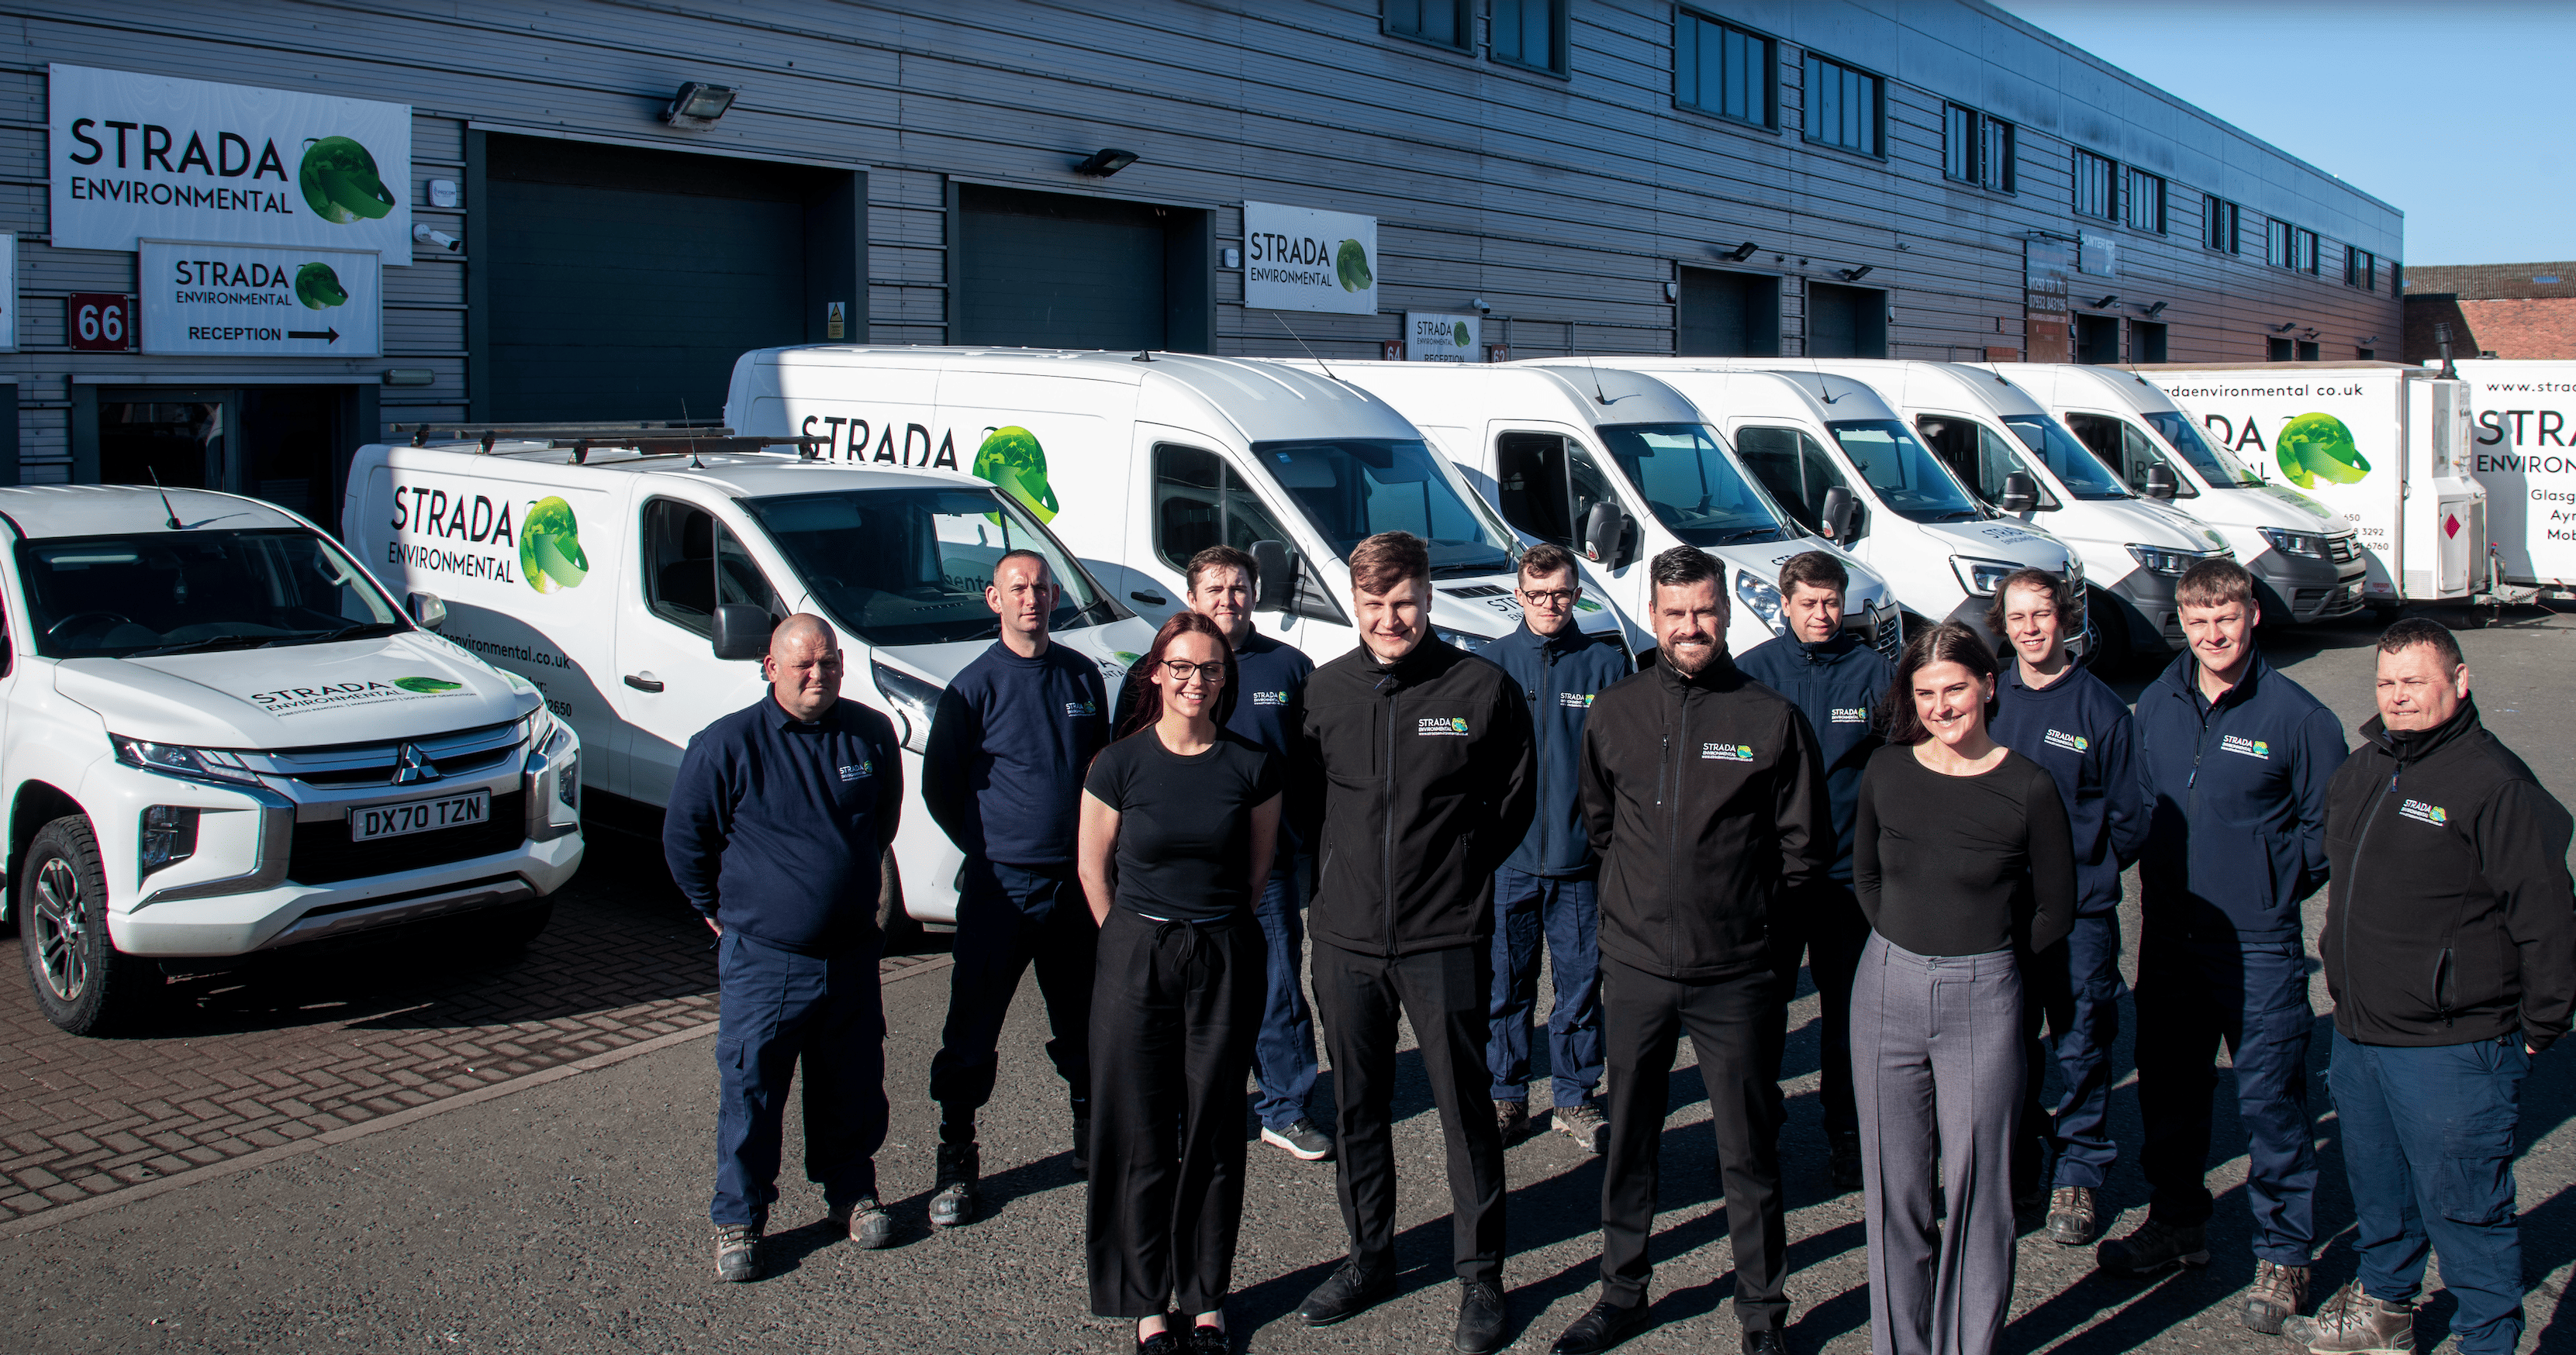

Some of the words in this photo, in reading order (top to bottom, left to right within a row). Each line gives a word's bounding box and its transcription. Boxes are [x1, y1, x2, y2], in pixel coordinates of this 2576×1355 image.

[69, 118, 288, 181] STRADA
[71, 177, 293, 214] ENVIRONMENTAL
[1250, 232, 1331, 267] STRADA
[175, 260, 289, 288] STRADA
[1251, 267, 1332, 287] ENVIRONMENTAL
[2028, 277, 2045, 291] 01292
[2046, 279, 2056, 293] 737
[2056, 281, 2066, 295] 727
[176, 291, 292, 306] ENVIRONMENTAL
[2029, 295, 2046, 309] 07932
[2047, 297, 2066, 312] 843196
[79, 304, 123, 341] 66
[1417, 321, 1452, 336] STRADA
[189, 326, 281, 341] RECEPTION
[1386, 347, 1401, 361] 64
[1424, 354, 1465, 363] RECEPTION
[1493, 350, 1505, 363] 62
[2317, 384, 2363, 396] co.uk
[799, 415, 958, 471] STRADA
[2477, 455, 2576, 473] ENVIRON
[2531, 489, 2576, 505] Glasg
[390, 485, 515, 547] STRADA
[389, 542, 515, 583] ENVIRONMENTAL
[251, 681, 392, 704] STRADA
[265, 689, 406, 712] ENVIRONMENTAL
[1560, 692, 1585, 701] STRADA
[278, 709, 312, 717] ASBESTOS
[350, 698, 399, 706] MANAGEMENT
[544, 697, 572, 717] 2650
[1418, 718, 1452, 727] STRADA
[2046, 729, 2075, 743] STRADA
[2223, 734, 2253, 748] STRADA
[1703, 743, 1737, 752] STRADA
[839, 764, 865, 774] STRADA
[2403, 798, 2433, 813] STRADA
[365, 805, 428, 836] DX70
[437, 796, 482, 824] TZN
